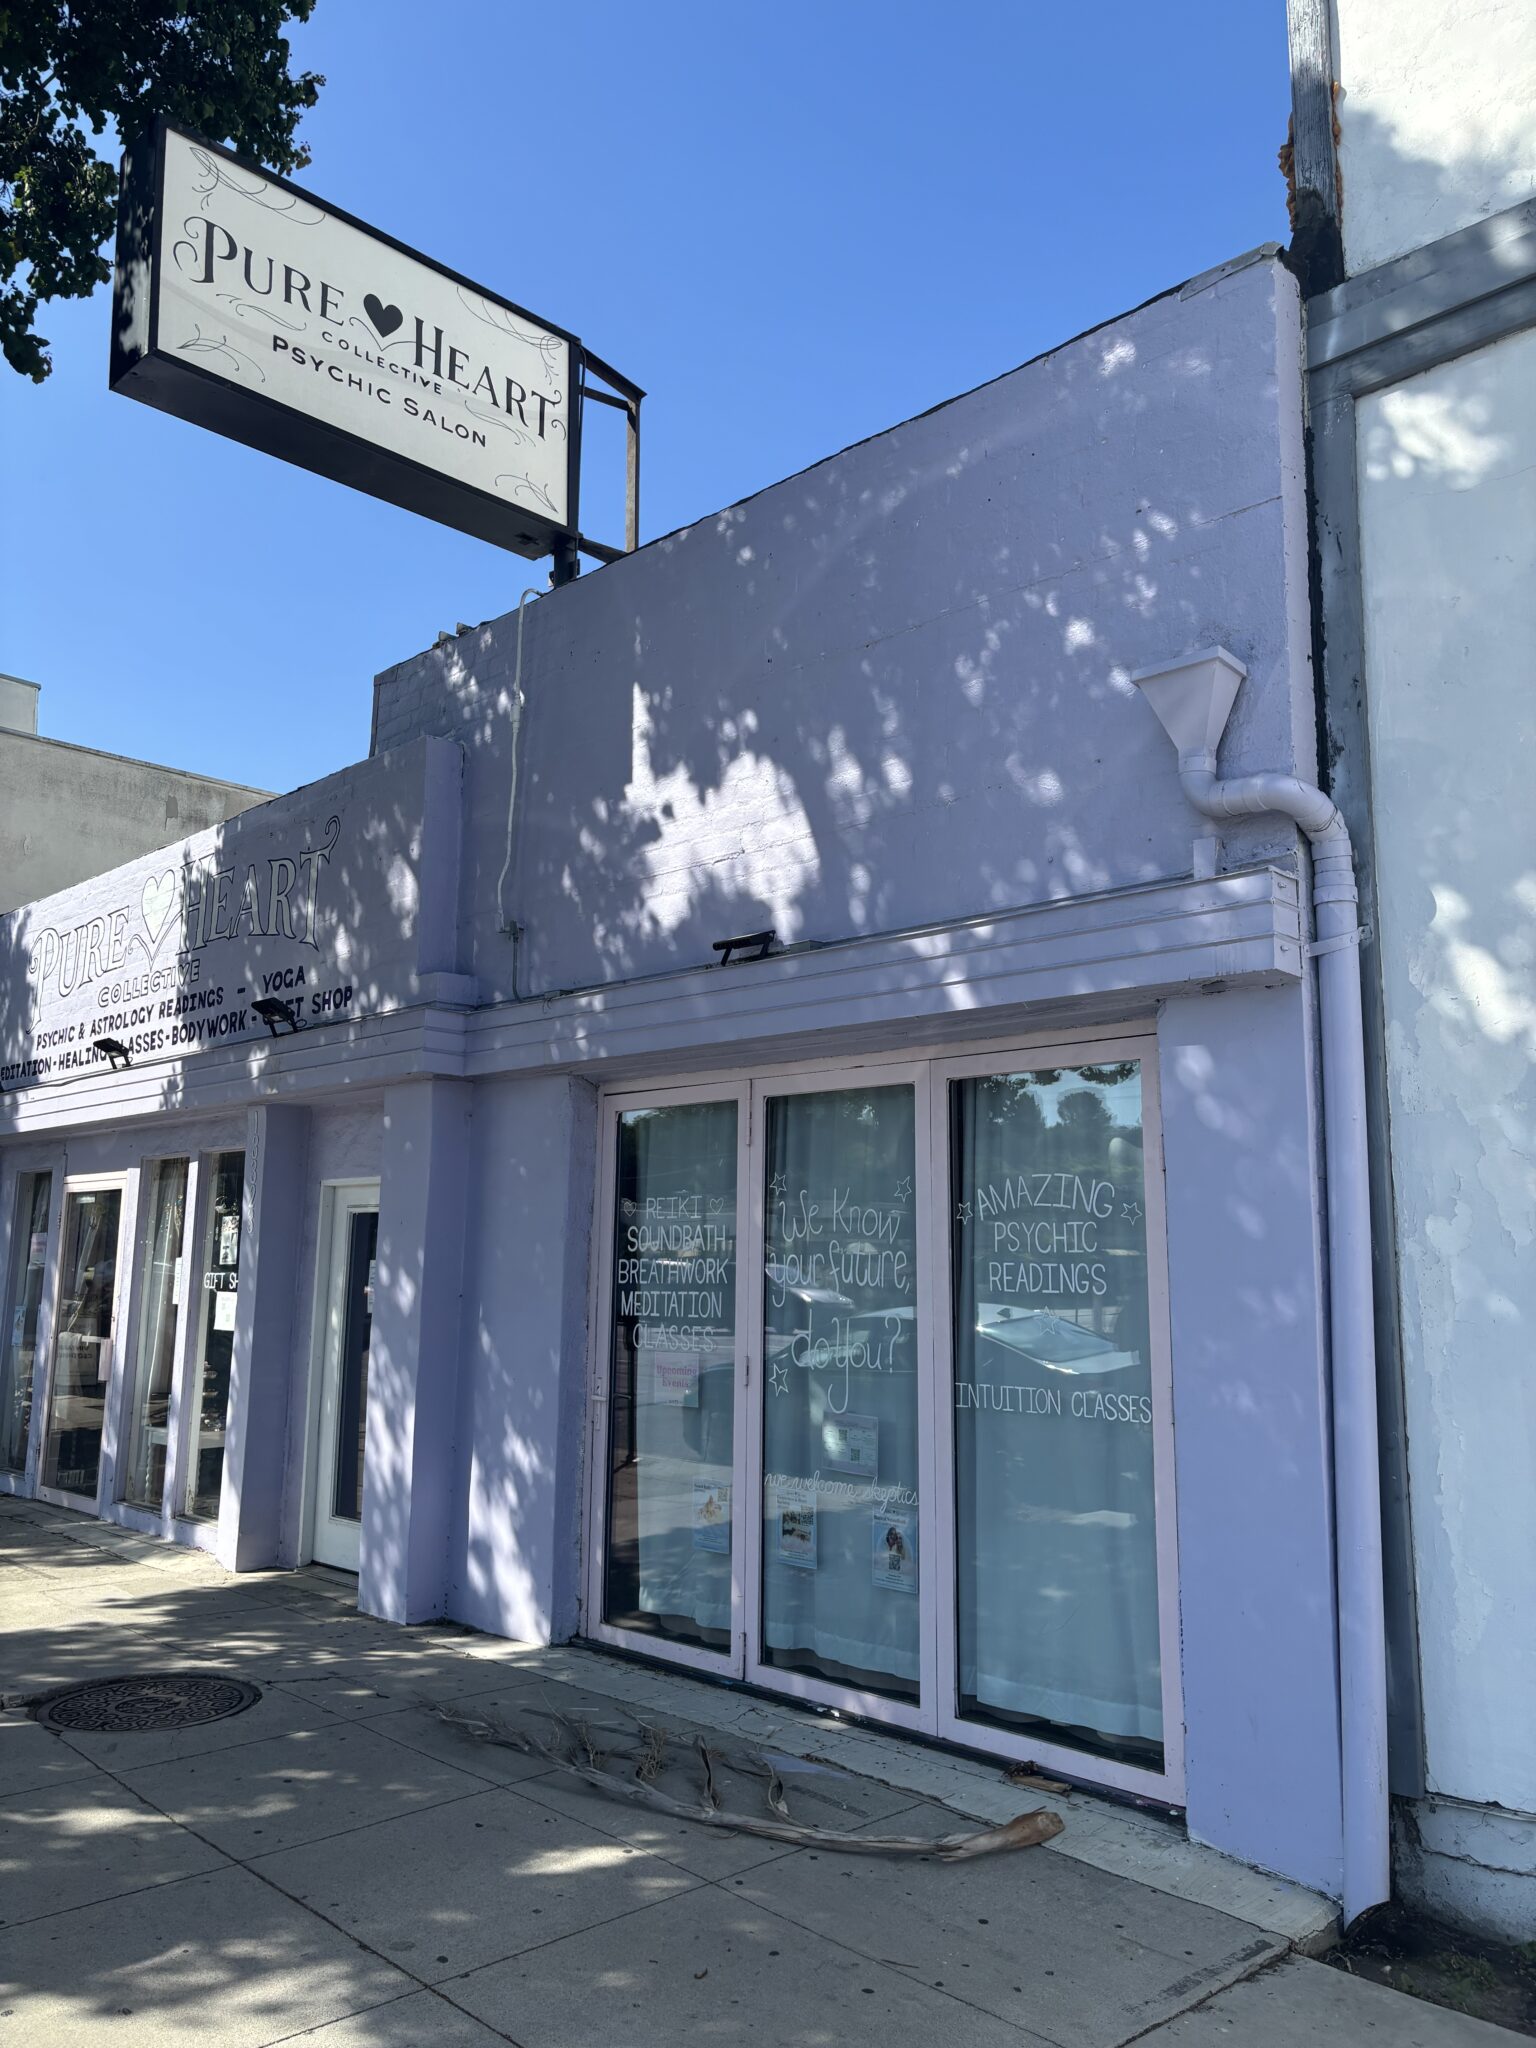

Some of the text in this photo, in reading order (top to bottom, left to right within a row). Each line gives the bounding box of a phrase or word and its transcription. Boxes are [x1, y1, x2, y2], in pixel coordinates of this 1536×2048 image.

[173, 216, 567, 442] PURE HEART
[321, 330, 442, 396] COLLECTIVE
[272, 334, 487, 448] PSYCHIC SALON
[26, 815, 341, 1035] PURE HEART
[97, 957, 201, 1009] COLLECTIVE
[311, 985, 353, 1014] SHOP
[36, 1029, 75, 1051] PSYCHIC
[78, 1022, 85, 1040] &
[89, 1004, 155, 1037] ASTROLOGY
[158, 986, 224, 1020] READINGS
[262, 965, 306, 994] YOGA
[645, 1195, 703, 1220] REIKI
[778, 1188, 824, 1243] We
[976, 1172, 1116, 1222] AMAZING
[626, 1223, 727, 1253] SOUNDBATH
[993, 1220, 1098, 1254] PSYCHIC
[203, 1271, 226, 1289] GIFT
[617, 1257, 729, 1286] BREATHWORK
[768, 1251, 825, 1308] your
[988, 1261, 1108, 1296] READINGS
[620, 1290, 723, 1319] MEDITATION
[632, 1321, 715, 1353] CLASSES
[954, 1381, 1153, 1424] INTUITION CLASSES
[789, 1469, 858, 1498] welcome
